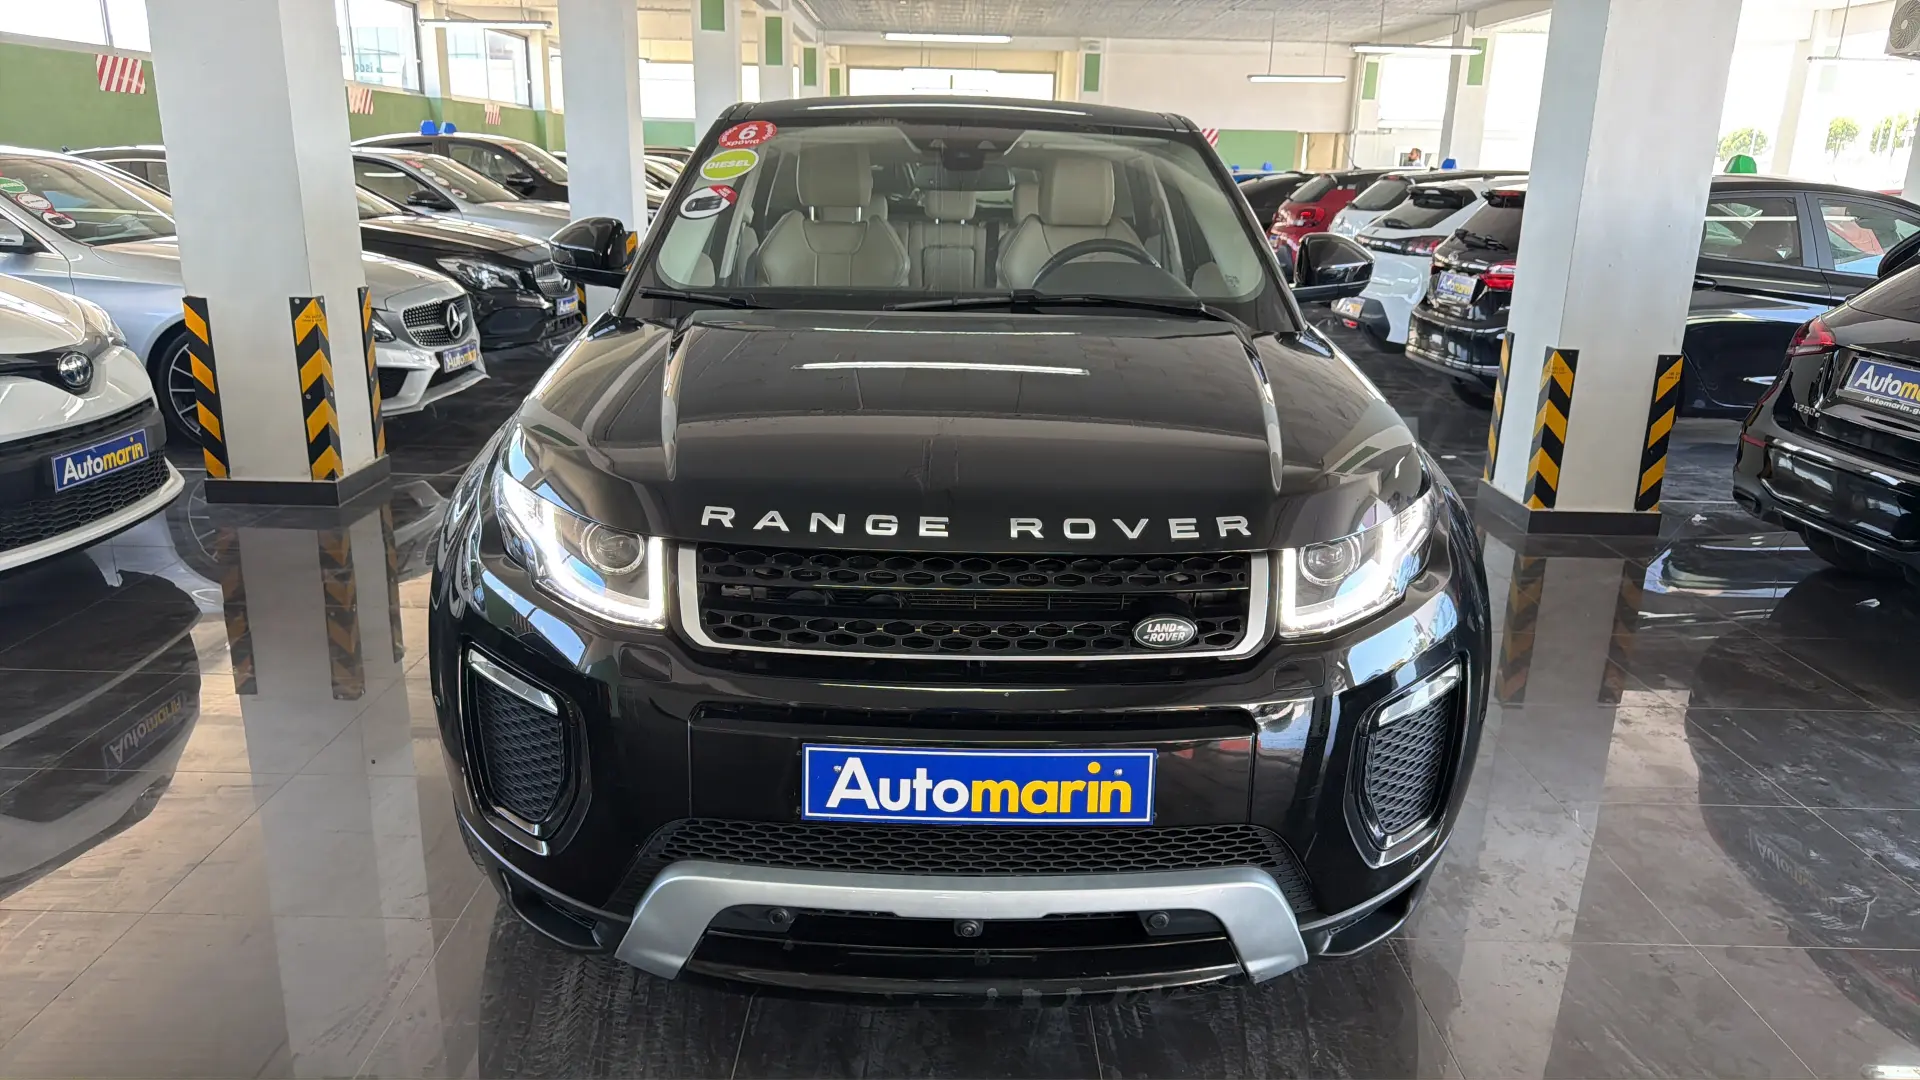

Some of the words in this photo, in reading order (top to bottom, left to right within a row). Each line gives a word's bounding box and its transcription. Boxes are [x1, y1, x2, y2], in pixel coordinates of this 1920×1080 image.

[738, 126, 759, 140] 6
[705, 159, 751, 170] DIESEL
[1854, 364, 1920, 402] Autom
[1863, 395, 1920, 415] Automarin.g
[62, 436, 144, 485] Automarin
[701, 505, 950, 537] RANGE
[1009, 515, 1252, 539] ROVER
[1147, 623, 1177, 633] LAND
[1149, 632, 1186, 642] ROVER
[825, 757, 1132, 814] Automarin
